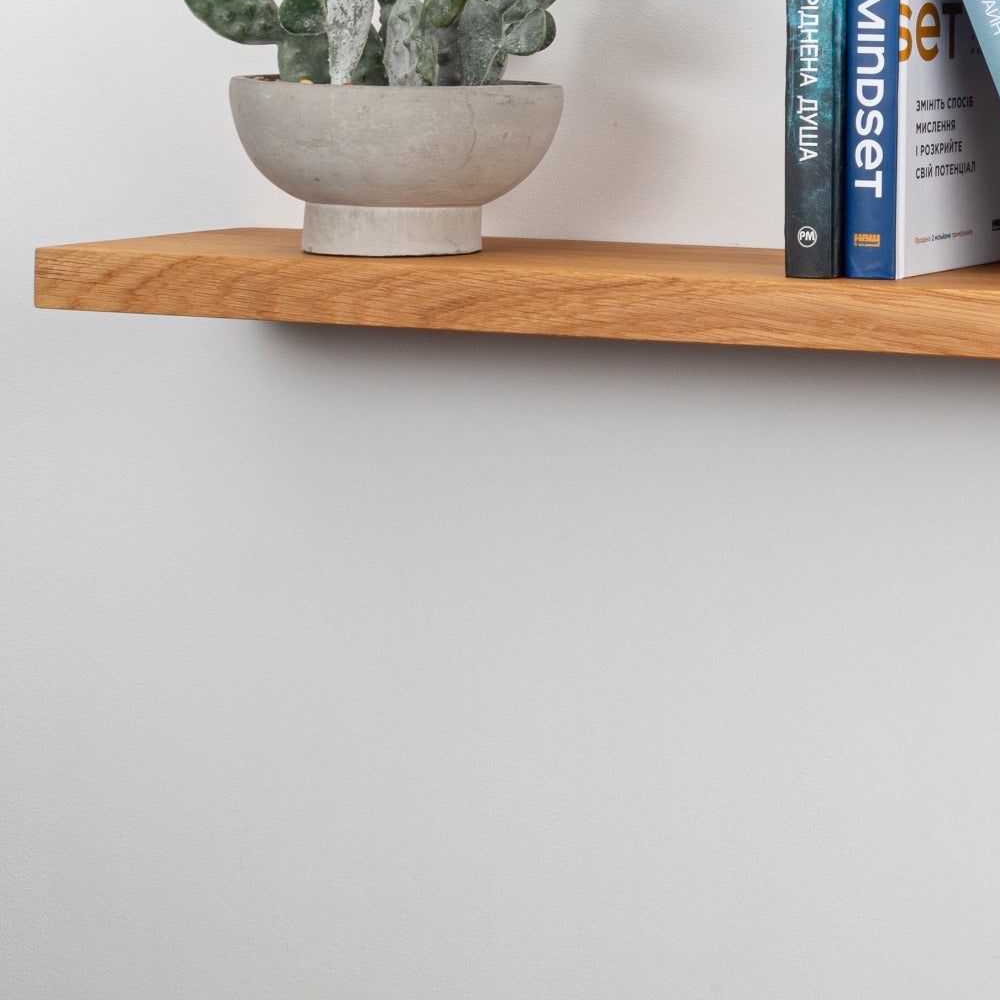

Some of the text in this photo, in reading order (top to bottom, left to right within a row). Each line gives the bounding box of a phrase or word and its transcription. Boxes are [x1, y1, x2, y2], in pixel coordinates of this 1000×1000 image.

[916, 96, 974, 112] ЗМІНІТЬ СПОСІБ
[796, 95, 819, 162] ДУША
[915, 119, 956, 134] МИСЛЕННЯ
[920, 139, 963, 156] РОЗКРИЙТЕ
[915, 161, 976, 179] СВІЙ ПОТЕНЦІАЛ
